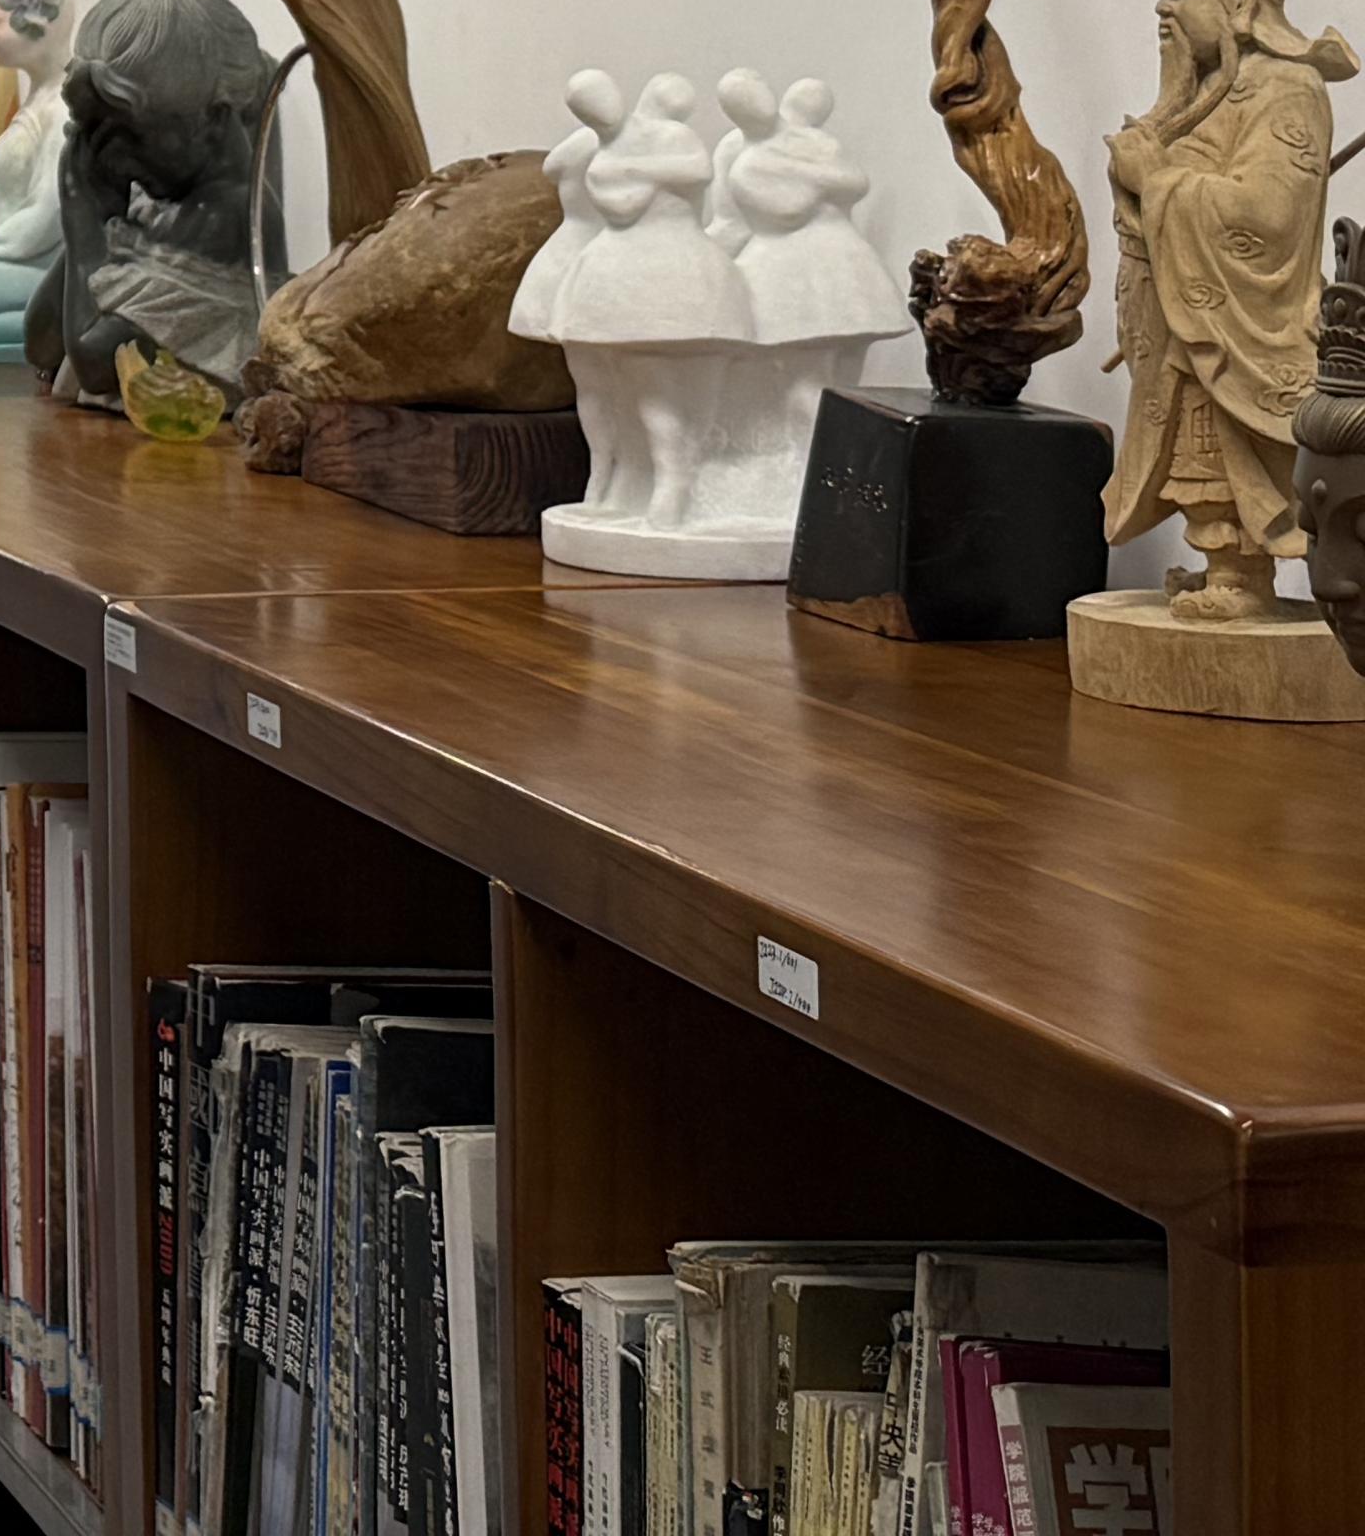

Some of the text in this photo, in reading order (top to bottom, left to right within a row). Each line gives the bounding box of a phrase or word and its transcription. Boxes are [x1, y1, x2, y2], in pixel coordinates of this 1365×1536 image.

[861, 1344, 890, 1375] 经
[1005, 1441, 1036, 1536] 学院派范
